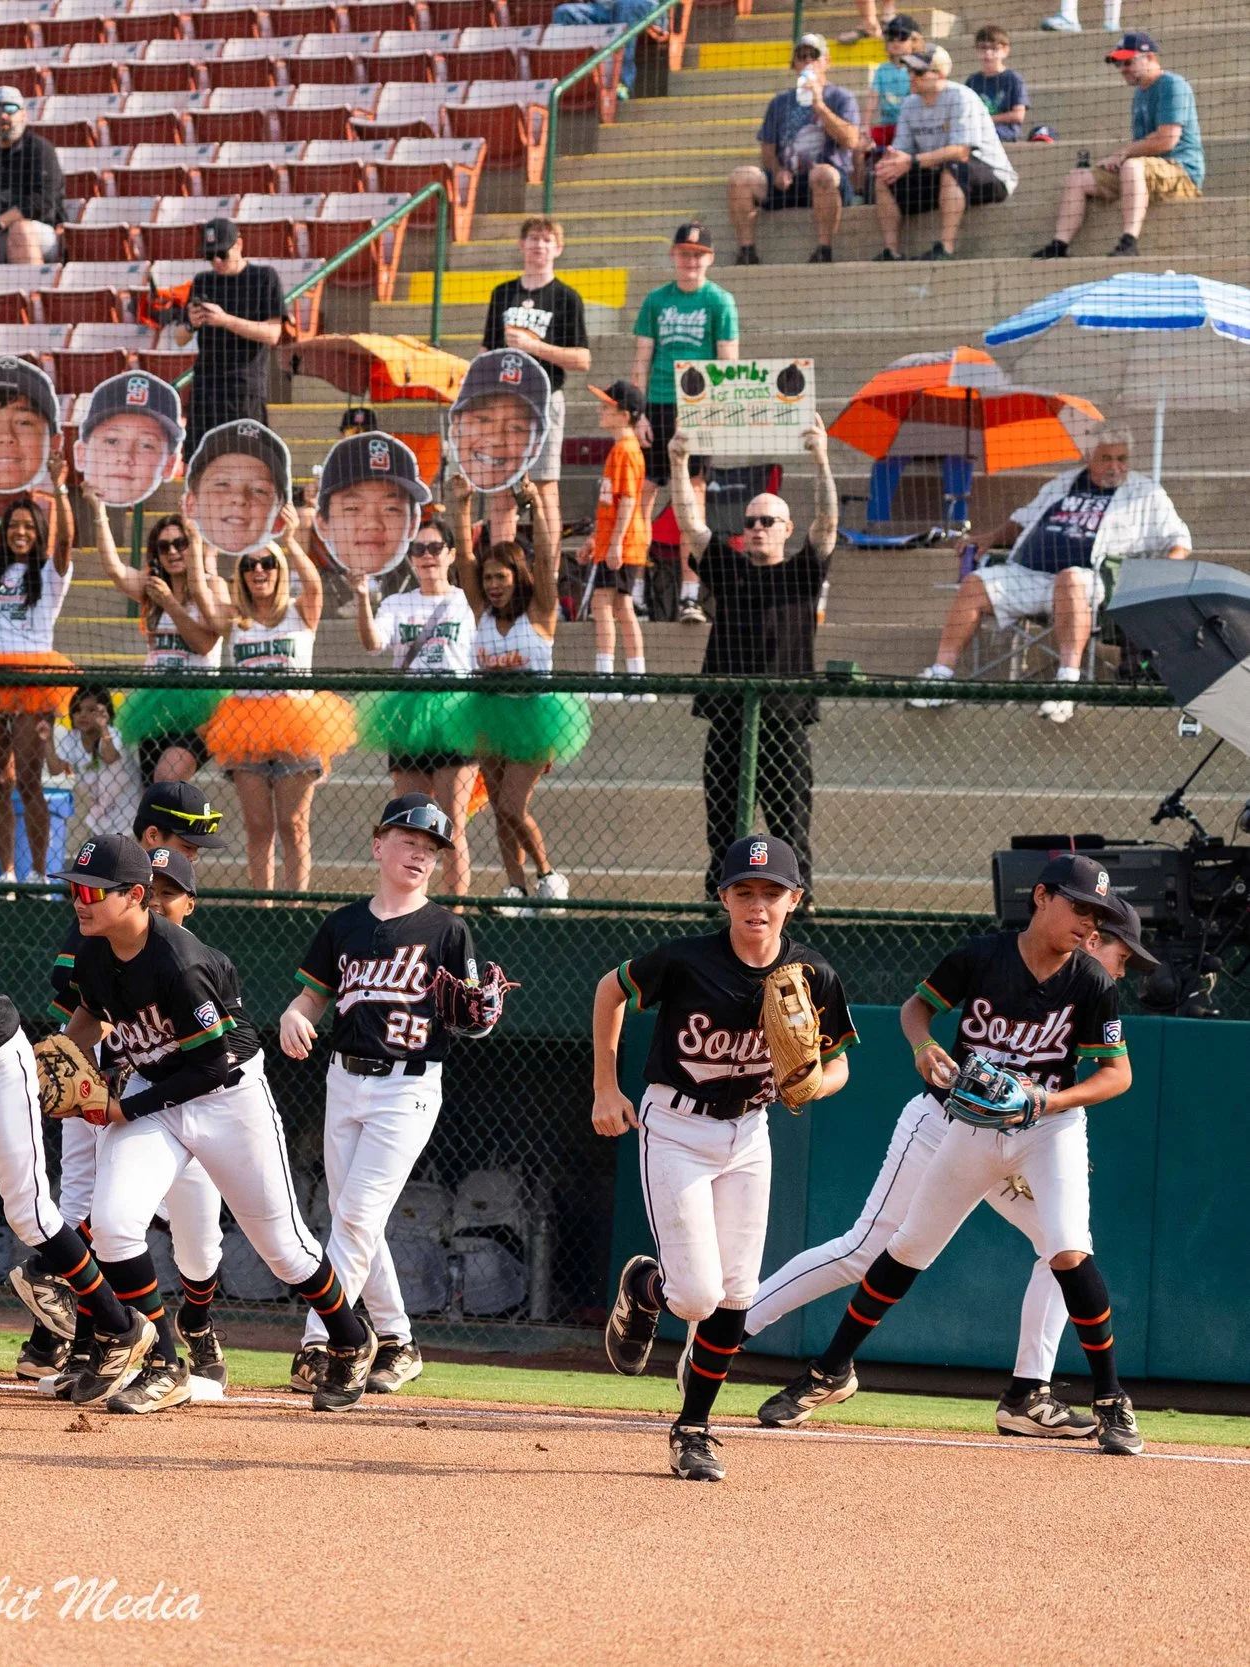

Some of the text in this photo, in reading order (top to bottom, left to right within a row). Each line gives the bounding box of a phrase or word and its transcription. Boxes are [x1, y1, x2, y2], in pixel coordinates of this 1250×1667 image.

[1061, 496, 1107, 512] WES
[750, 842, 768, 866] S
[385, 1010, 430, 1050] 25
[677, 1012, 771, 1062] Sou
[961, 997, 1075, 1057] South
